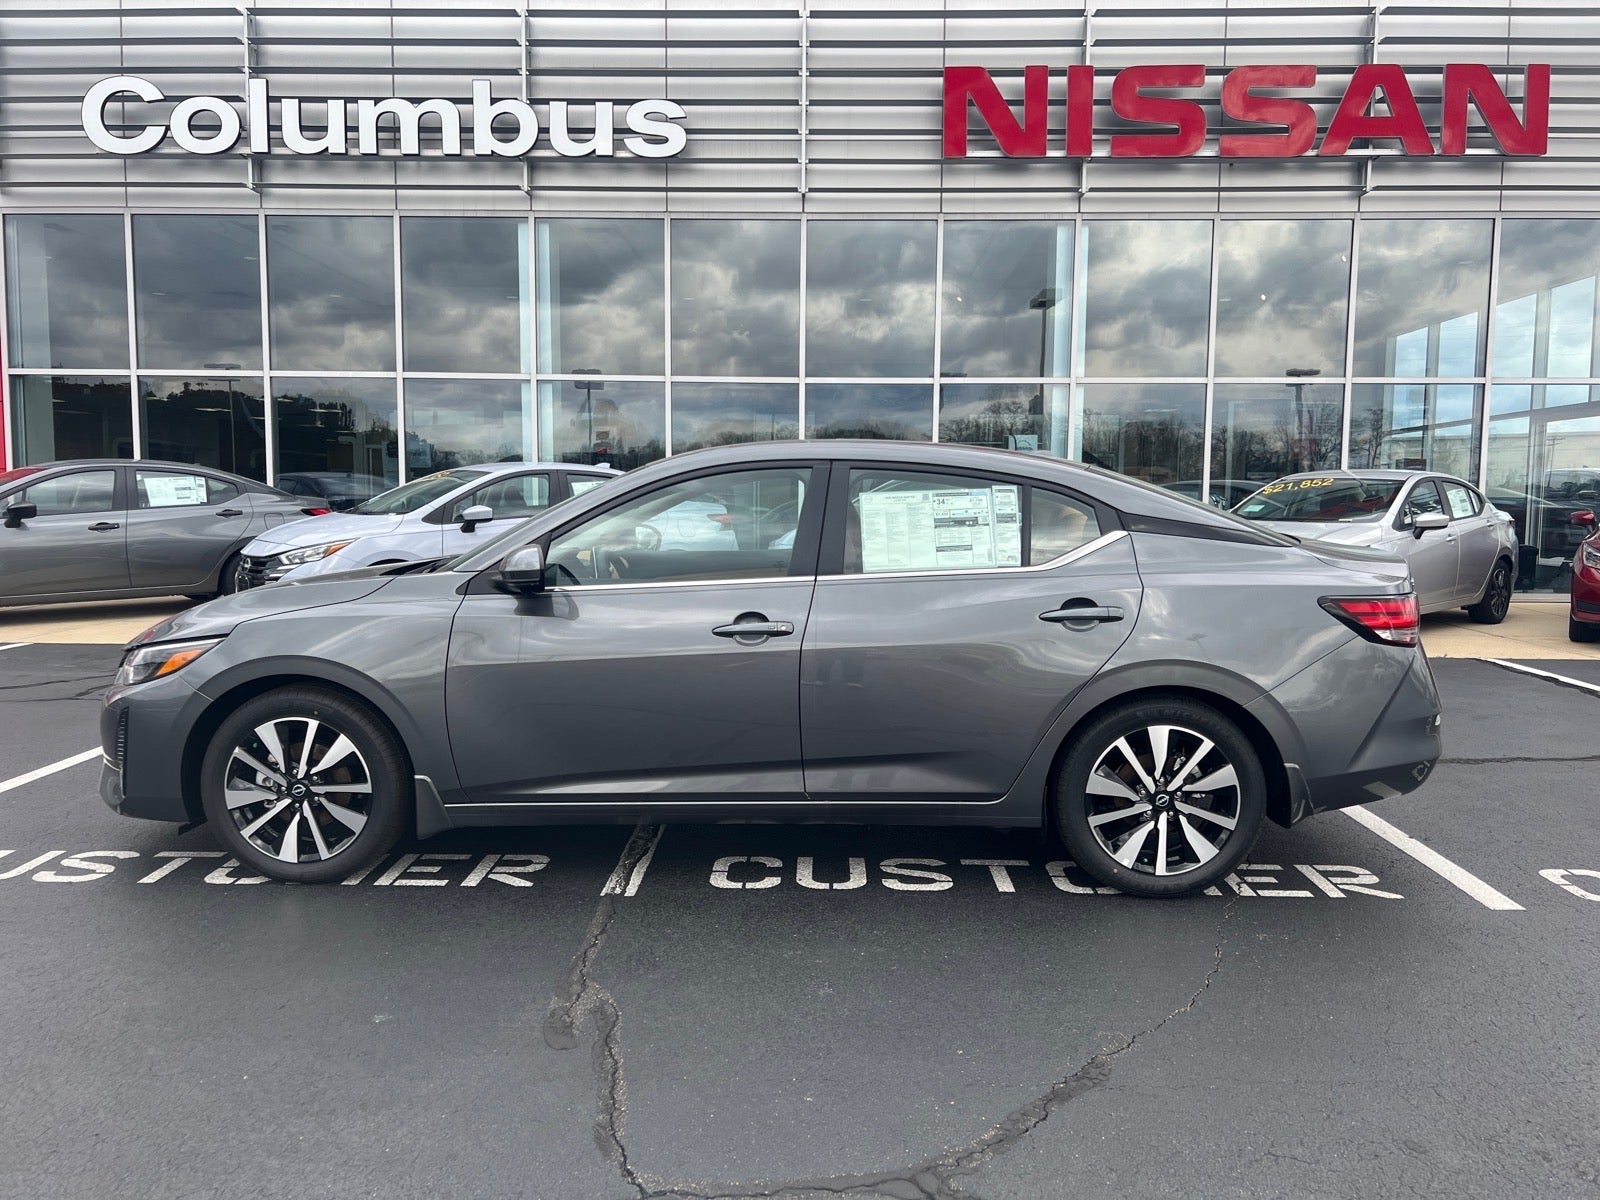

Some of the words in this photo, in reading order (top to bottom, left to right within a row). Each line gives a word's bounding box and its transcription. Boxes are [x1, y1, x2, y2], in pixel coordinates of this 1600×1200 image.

[81, 76, 687, 157] Columbus
[943, 64, 1549, 158] NISSAN
[1263, 477, 1334, 495] $21,852
[709, 856, 1404, 899] CUSTOER
